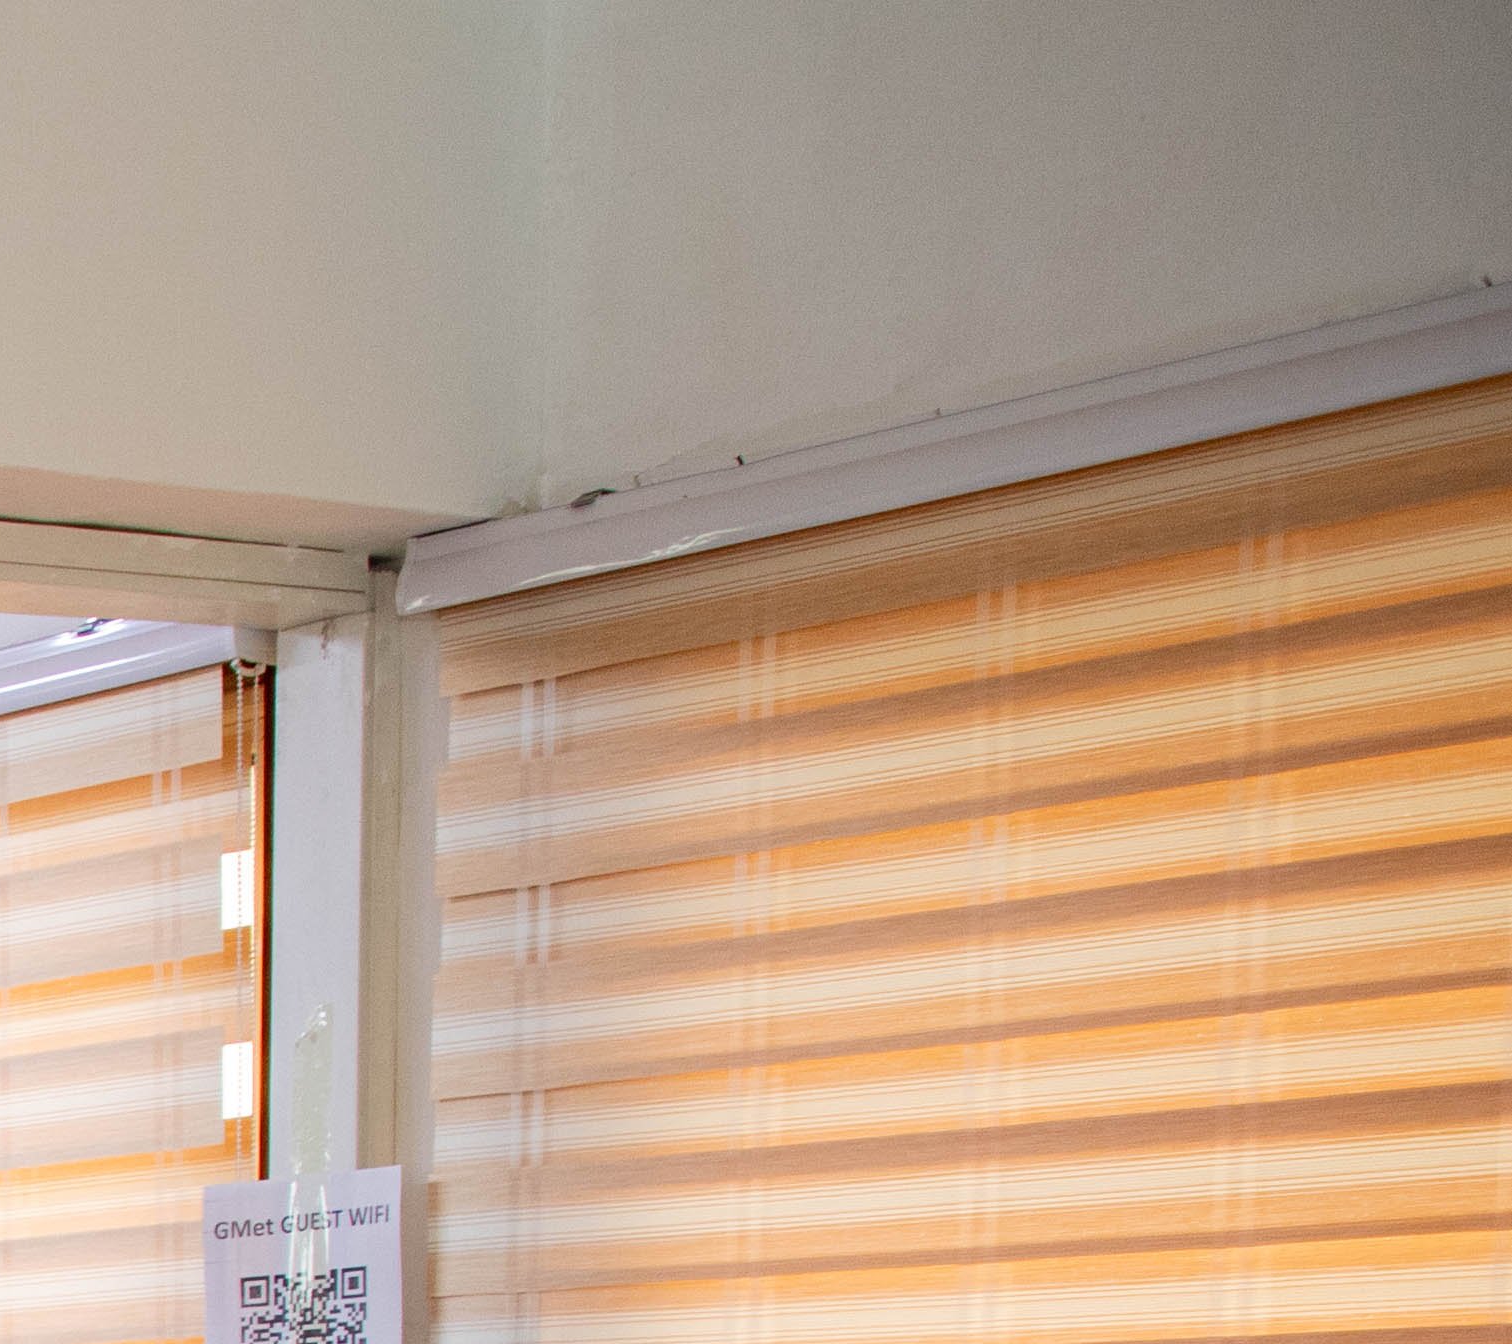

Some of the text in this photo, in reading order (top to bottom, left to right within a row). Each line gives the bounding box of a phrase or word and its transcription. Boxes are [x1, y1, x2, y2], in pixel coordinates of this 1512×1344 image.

[213, 1204, 391, 1241] GMet GUEST WIFI
